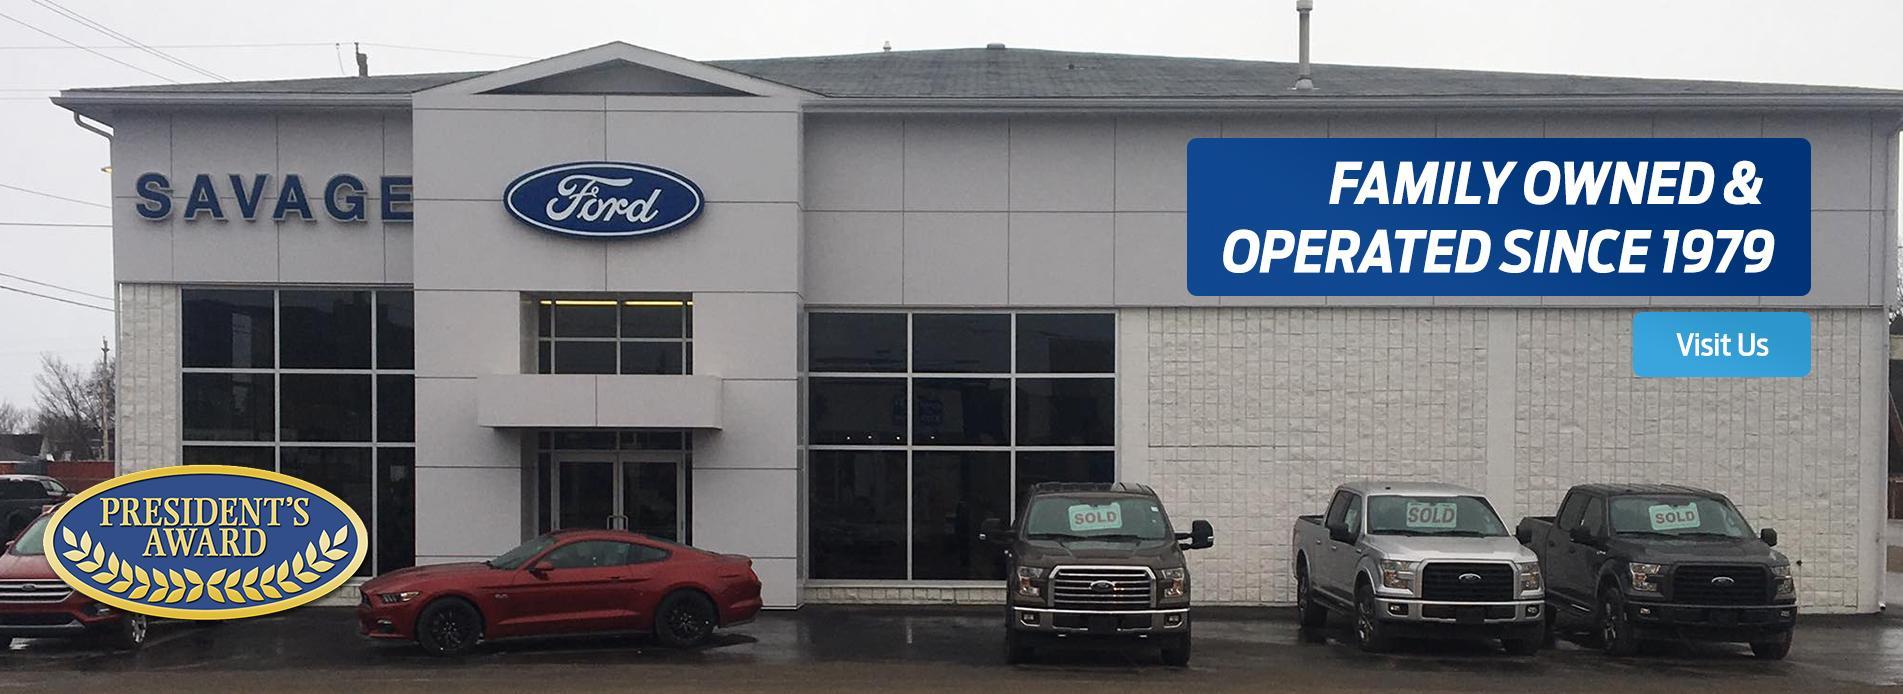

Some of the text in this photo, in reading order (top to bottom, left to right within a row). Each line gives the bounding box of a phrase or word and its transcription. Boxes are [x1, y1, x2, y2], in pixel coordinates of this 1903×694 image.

[135, 171, 413, 223] SAVAGE
[546, 174, 662, 223] Ford
[1074, 511, 1117, 525] SOLD
[1407, 506, 1456, 524] SOLD
[1654, 511, 1696, 525] SOLD
